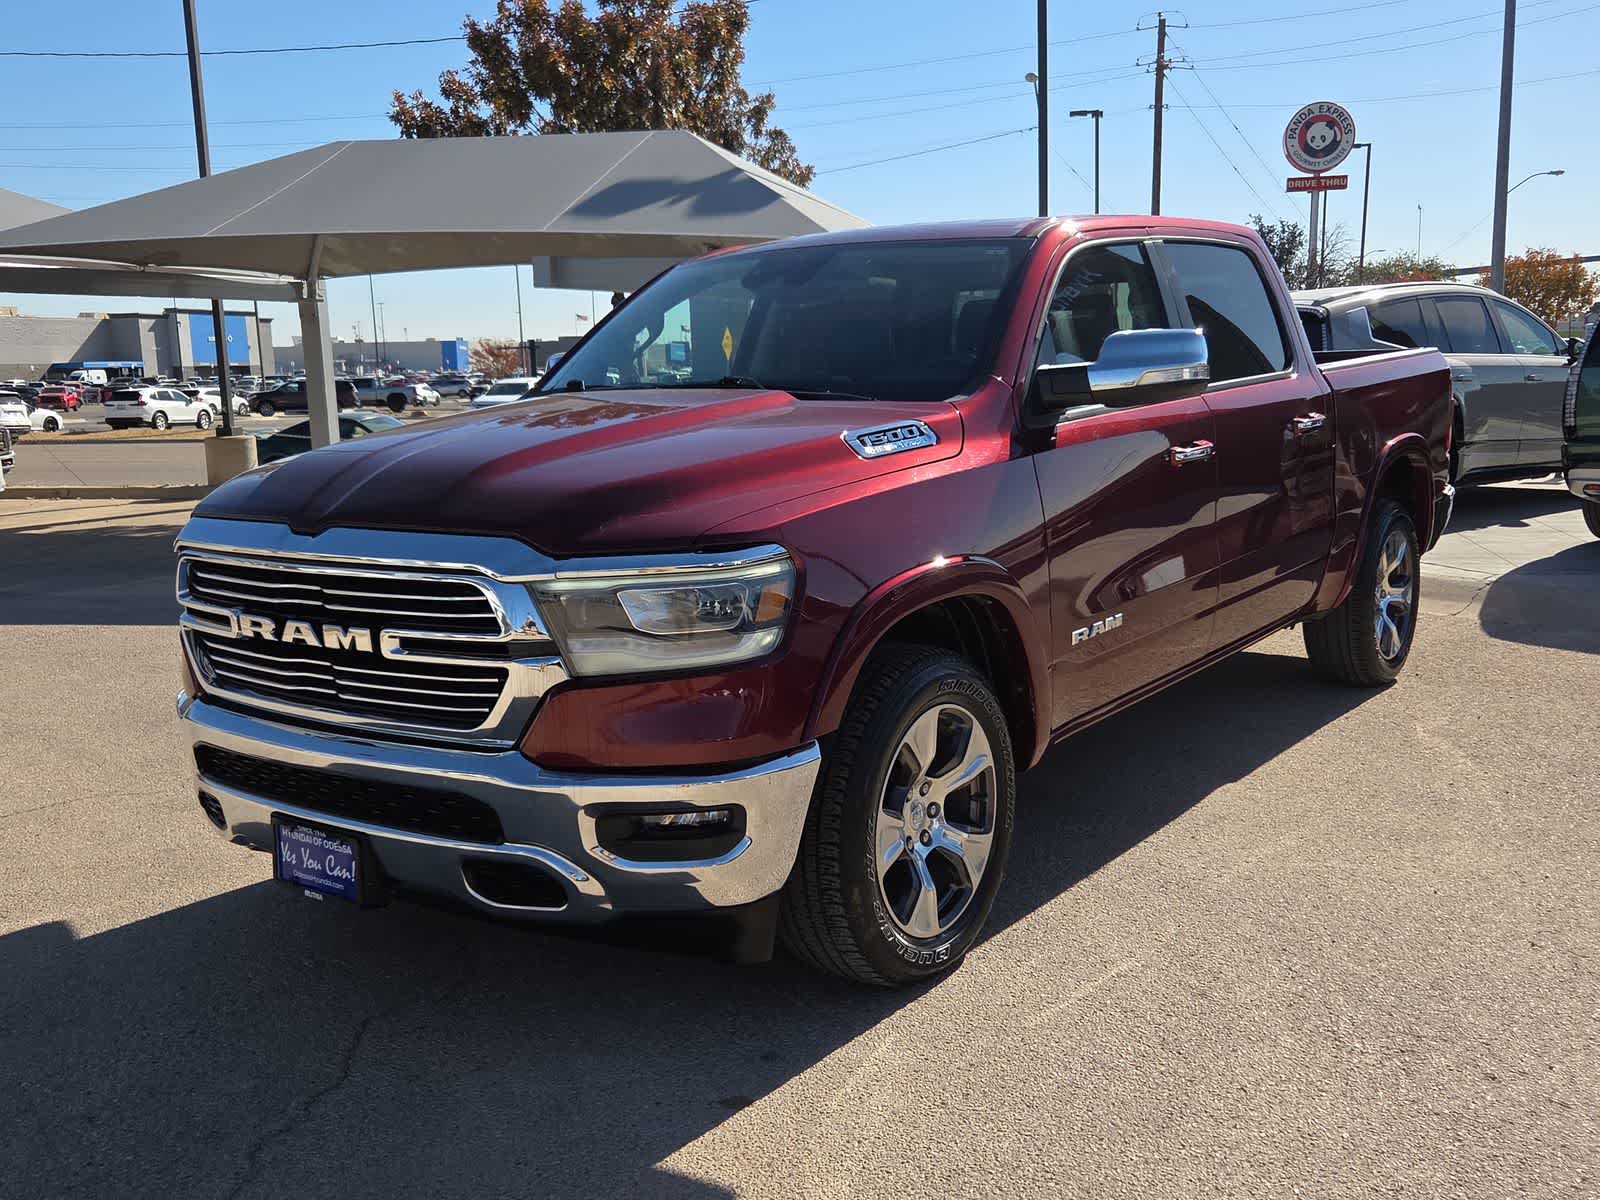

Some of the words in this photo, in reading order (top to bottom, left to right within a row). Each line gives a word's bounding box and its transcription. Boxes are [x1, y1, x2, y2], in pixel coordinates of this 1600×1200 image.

[1288, 108, 1315, 140] PANDA
[1318, 104, 1352, 135] EXPRESS
[1288, 179, 1317, 188] DRIVE
[1320, 178, 1347, 186] THRU
[859, 426, 920, 448] 1500
[239, 613, 373, 653] RAM
[1071, 613, 1123, 646] RAM
[282, 828, 312, 844] HYUNDAI
[313, 837, 322, 847] OF
[323, 840, 352, 855] ODESSA
[281, 841, 296, 864] Yes
[301, 847, 322, 870] You
[326, 855, 356, 882] Can!
[873, 900, 951, 964] DUELER
